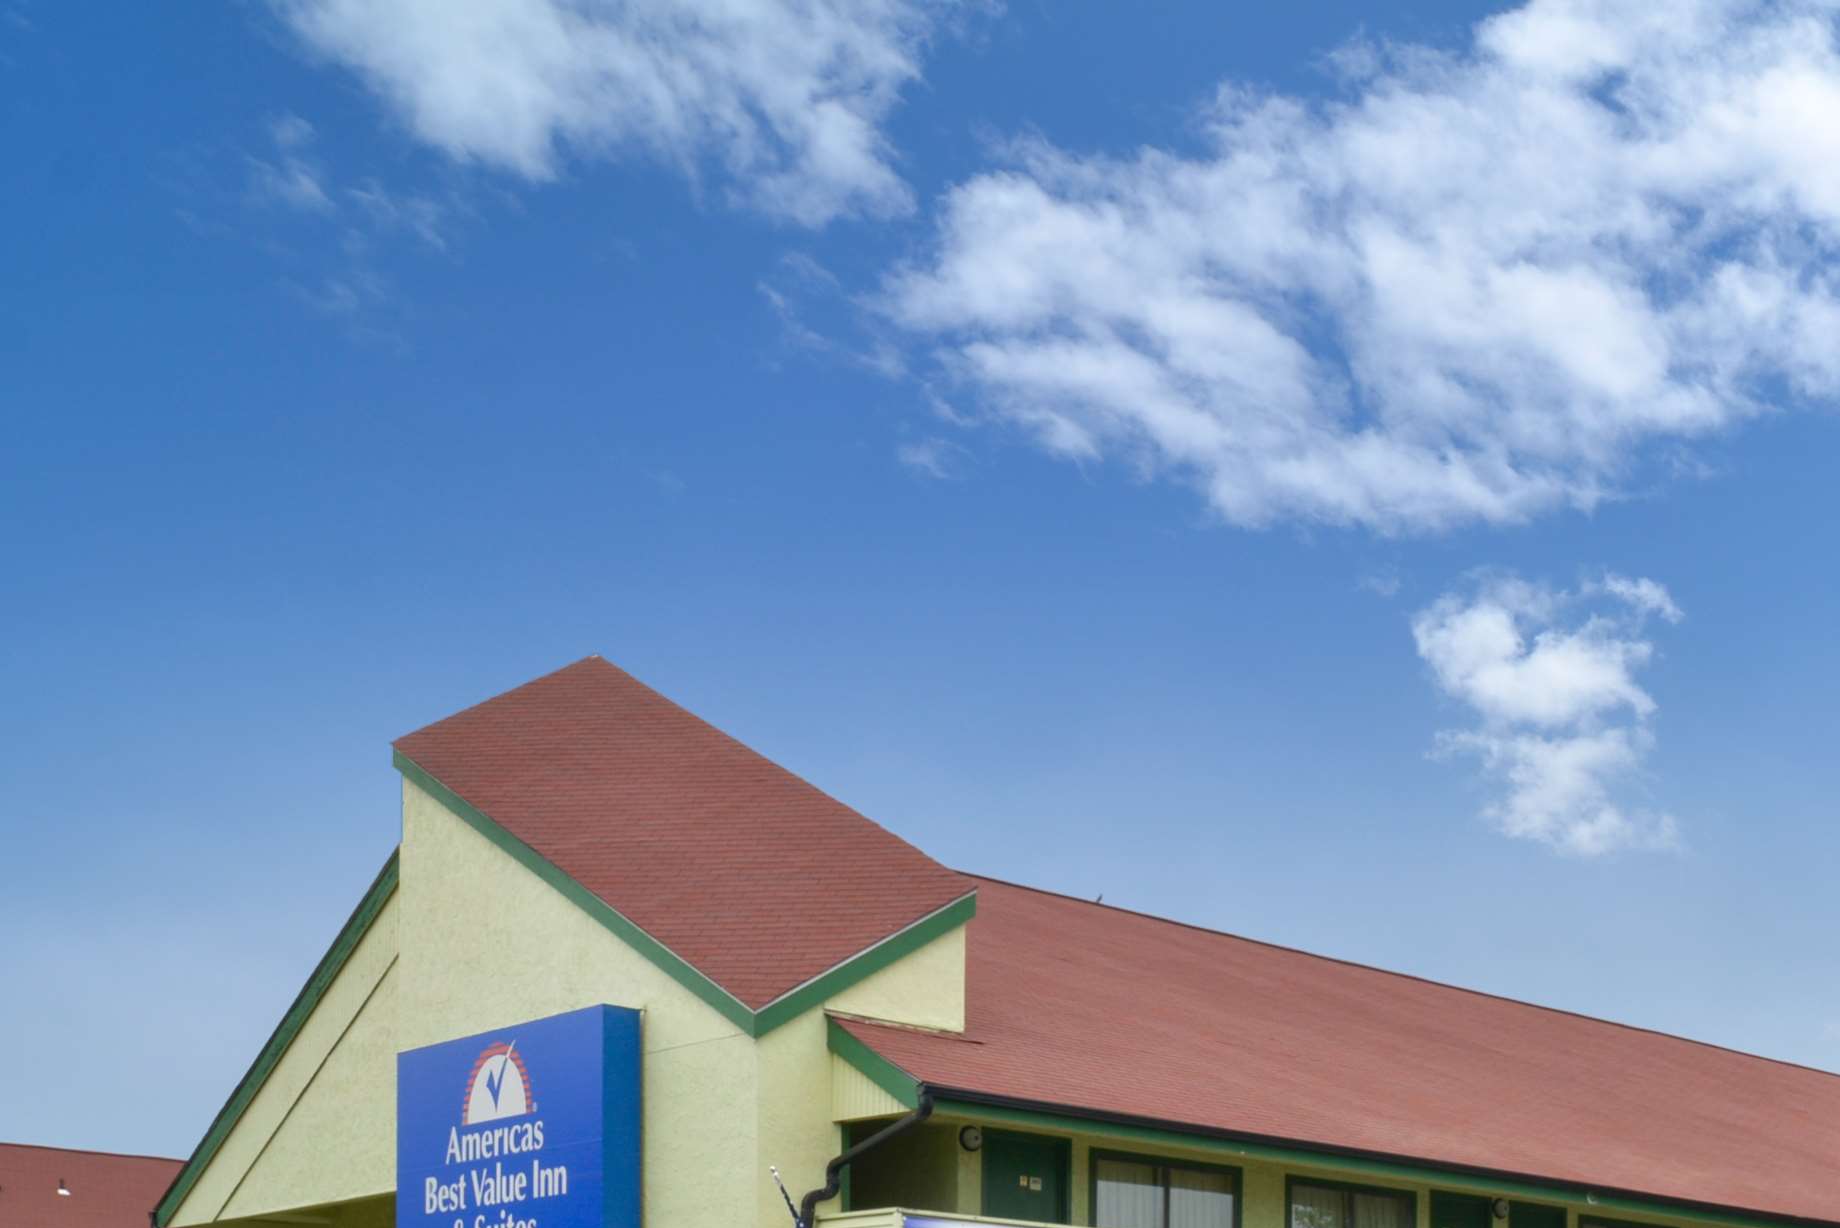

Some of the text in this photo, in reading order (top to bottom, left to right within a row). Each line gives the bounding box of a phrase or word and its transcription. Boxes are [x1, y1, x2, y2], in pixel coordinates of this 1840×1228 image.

[445, 1119, 544, 1165] Americas
[425, 1159, 567, 1214] Best Value Inn
